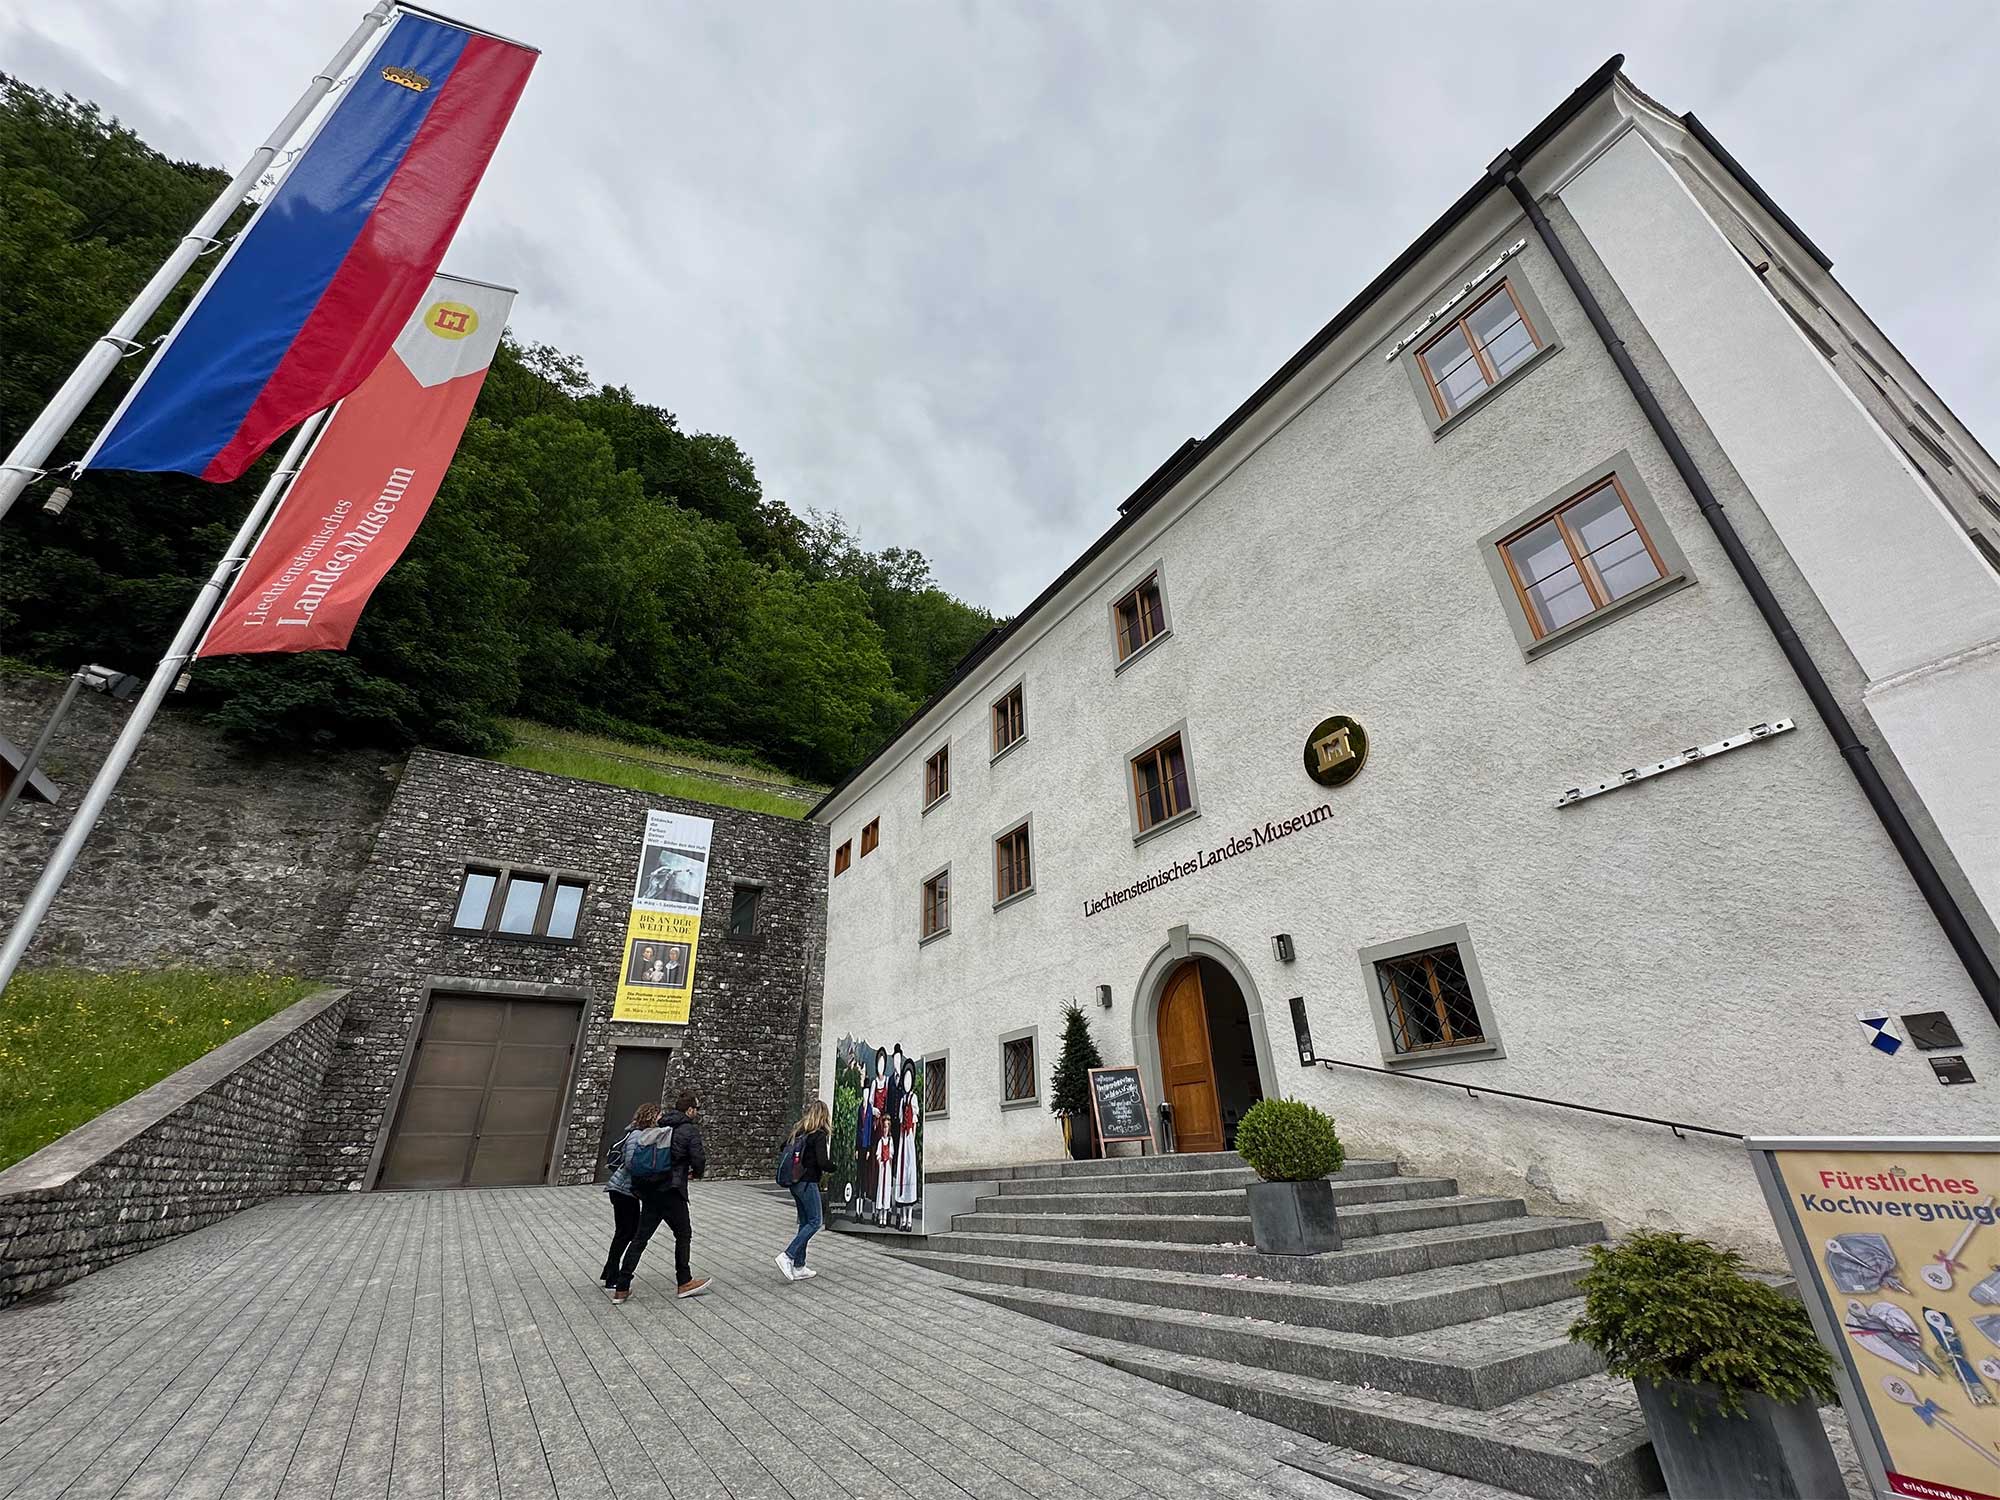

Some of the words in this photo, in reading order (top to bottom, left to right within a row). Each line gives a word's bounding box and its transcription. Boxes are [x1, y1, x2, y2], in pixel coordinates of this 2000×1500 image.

[243, 499, 353, 627] Liechtensteinisches
[1083, 858, 1198, 918] Liechtensteinisches
[639, 923, 663, 931] WELT
[667, 926, 692, 934] ENDE
[640, 915, 655, 923] BIS
[658, 916, 670, 924] AN
[674, 919, 692, 927] DER
[1819, 1170, 1979, 1195] Fürstliches
